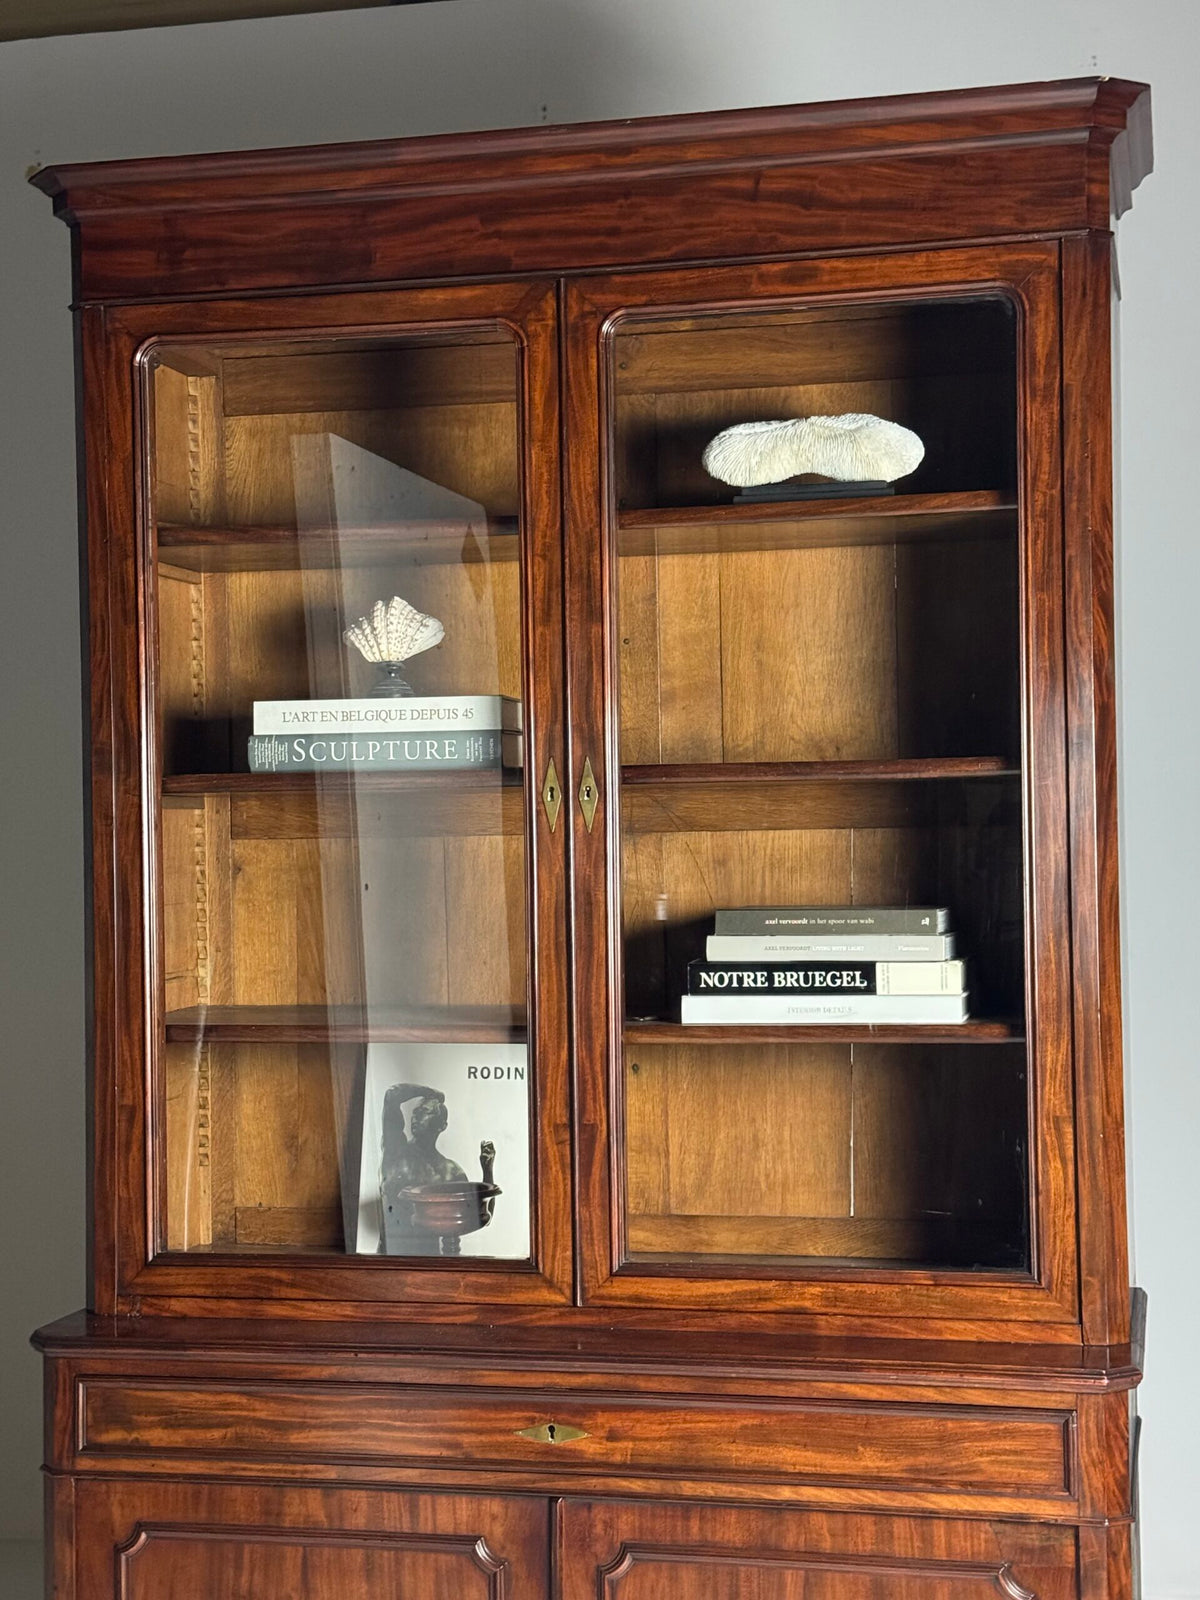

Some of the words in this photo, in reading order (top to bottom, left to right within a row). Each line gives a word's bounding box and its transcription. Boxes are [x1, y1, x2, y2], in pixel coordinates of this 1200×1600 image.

[282, 711, 318, 723] L'ART
[320, 711, 338, 722] EN
[341, 709, 407, 724] BELGIQUE
[410, 708, 459, 721] DEPUIS
[461, 707, 474, 719] 45
[700, 971, 768, 988] NOTRE
[773, 971, 867, 988] BRUEGEL
[467, 1066, 524, 1080] RODIN
